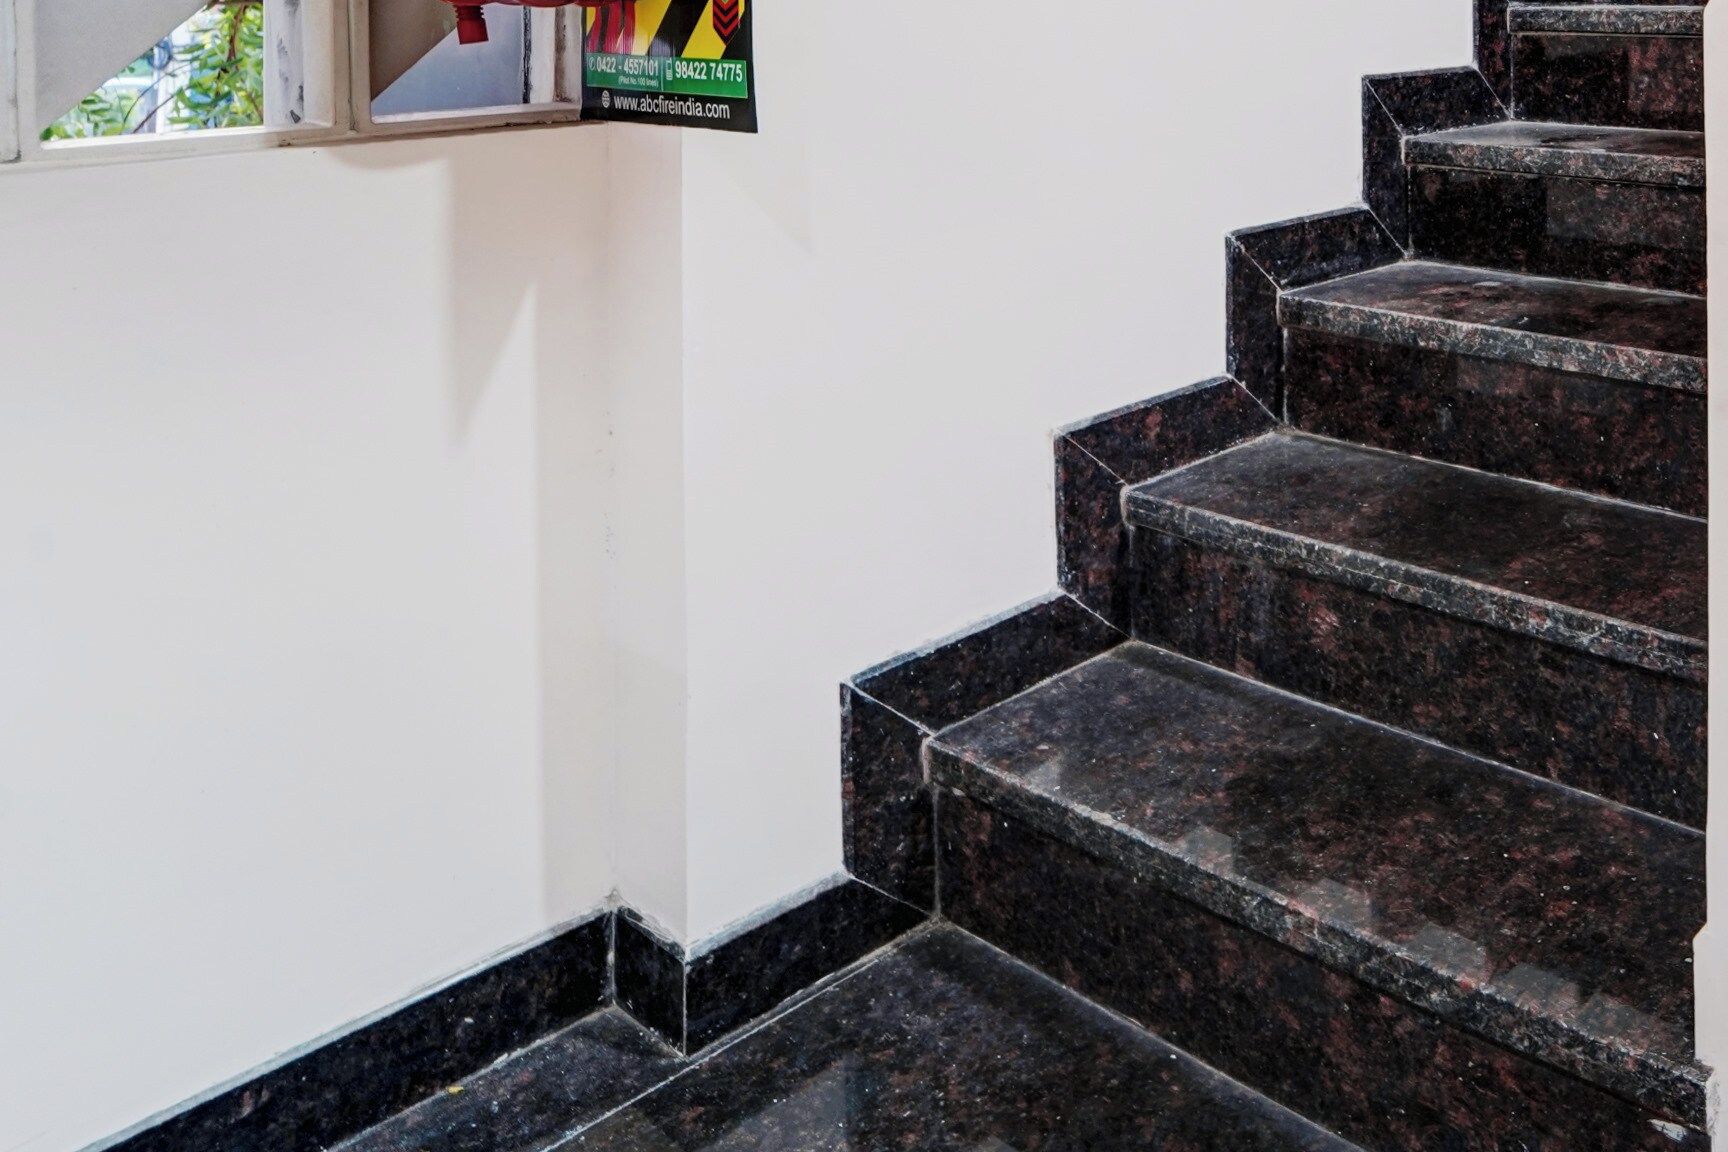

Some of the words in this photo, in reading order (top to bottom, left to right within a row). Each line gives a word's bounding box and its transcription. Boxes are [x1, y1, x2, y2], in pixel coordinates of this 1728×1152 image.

[596, 56, 616, 73] 0422
[623, 58, 659, 76] 4557101
[675, 62, 707, 80] 98422
[710, 62, 743, 83] 74775
[614, 94, 730, 119] www.abcfireindia.com
